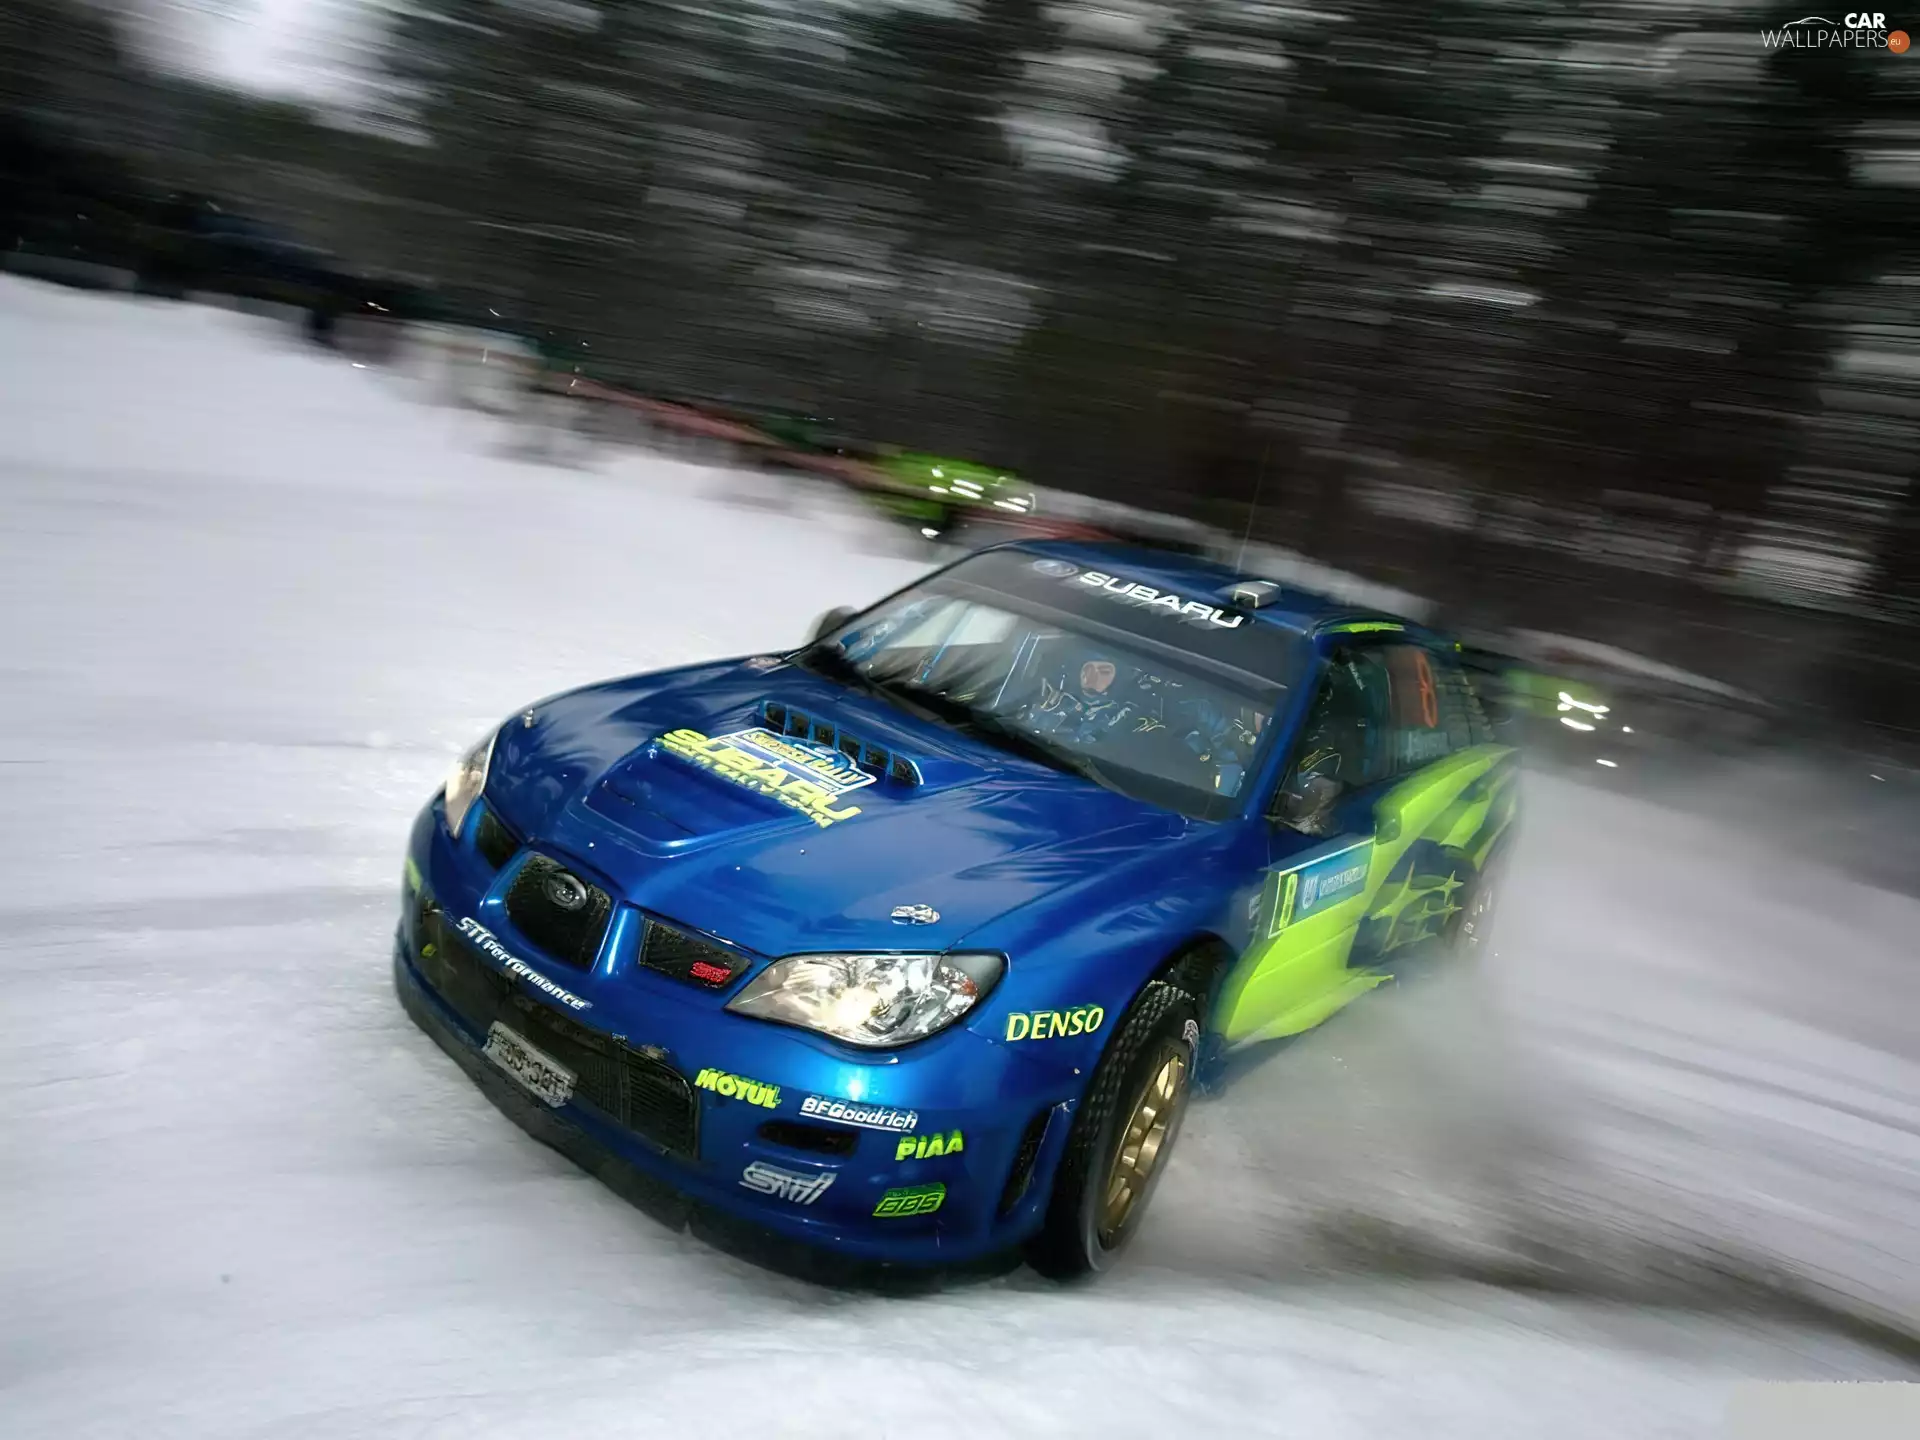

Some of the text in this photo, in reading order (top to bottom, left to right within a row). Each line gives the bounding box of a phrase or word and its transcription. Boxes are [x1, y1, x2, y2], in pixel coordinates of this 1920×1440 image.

[1079, 571, 1244, 629] SUBARU
[1006, 1007, 1104, 1042] DENSO
[695, 1069, 780, 1109] MOTUL
[801, 1096, 918, 1131] BFGoodrich
[895, 1131, 964, 1161] PIAA
